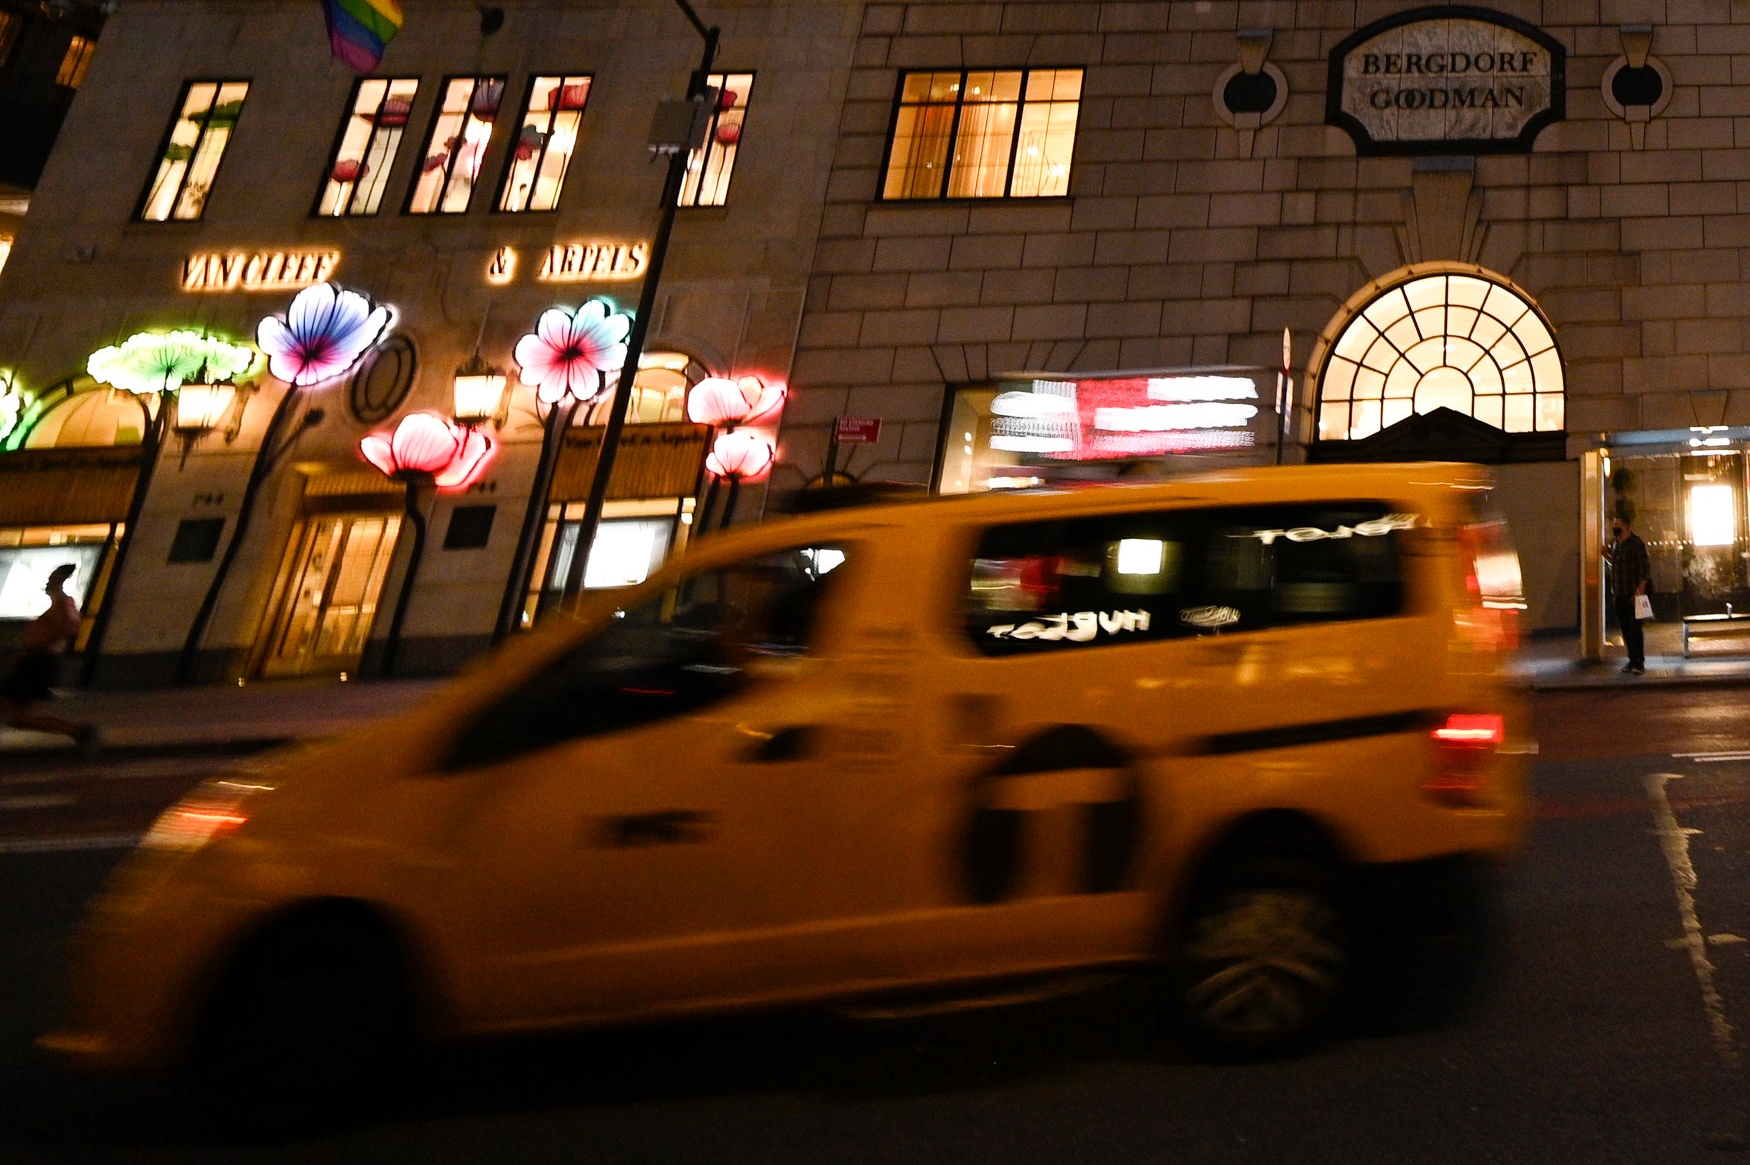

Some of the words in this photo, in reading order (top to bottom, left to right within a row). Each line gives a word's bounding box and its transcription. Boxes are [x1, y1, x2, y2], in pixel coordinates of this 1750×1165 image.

[1362, 51, 1537, 76] BERGDORF
[1370, 86, 1526, 110] GOODMAN
[181, 253, 237, 288] VAN
[240, 250, 338, 285] CLEEF
[489, 245, 510, 276] &
[536, 243, 648, 278] ARPELS
